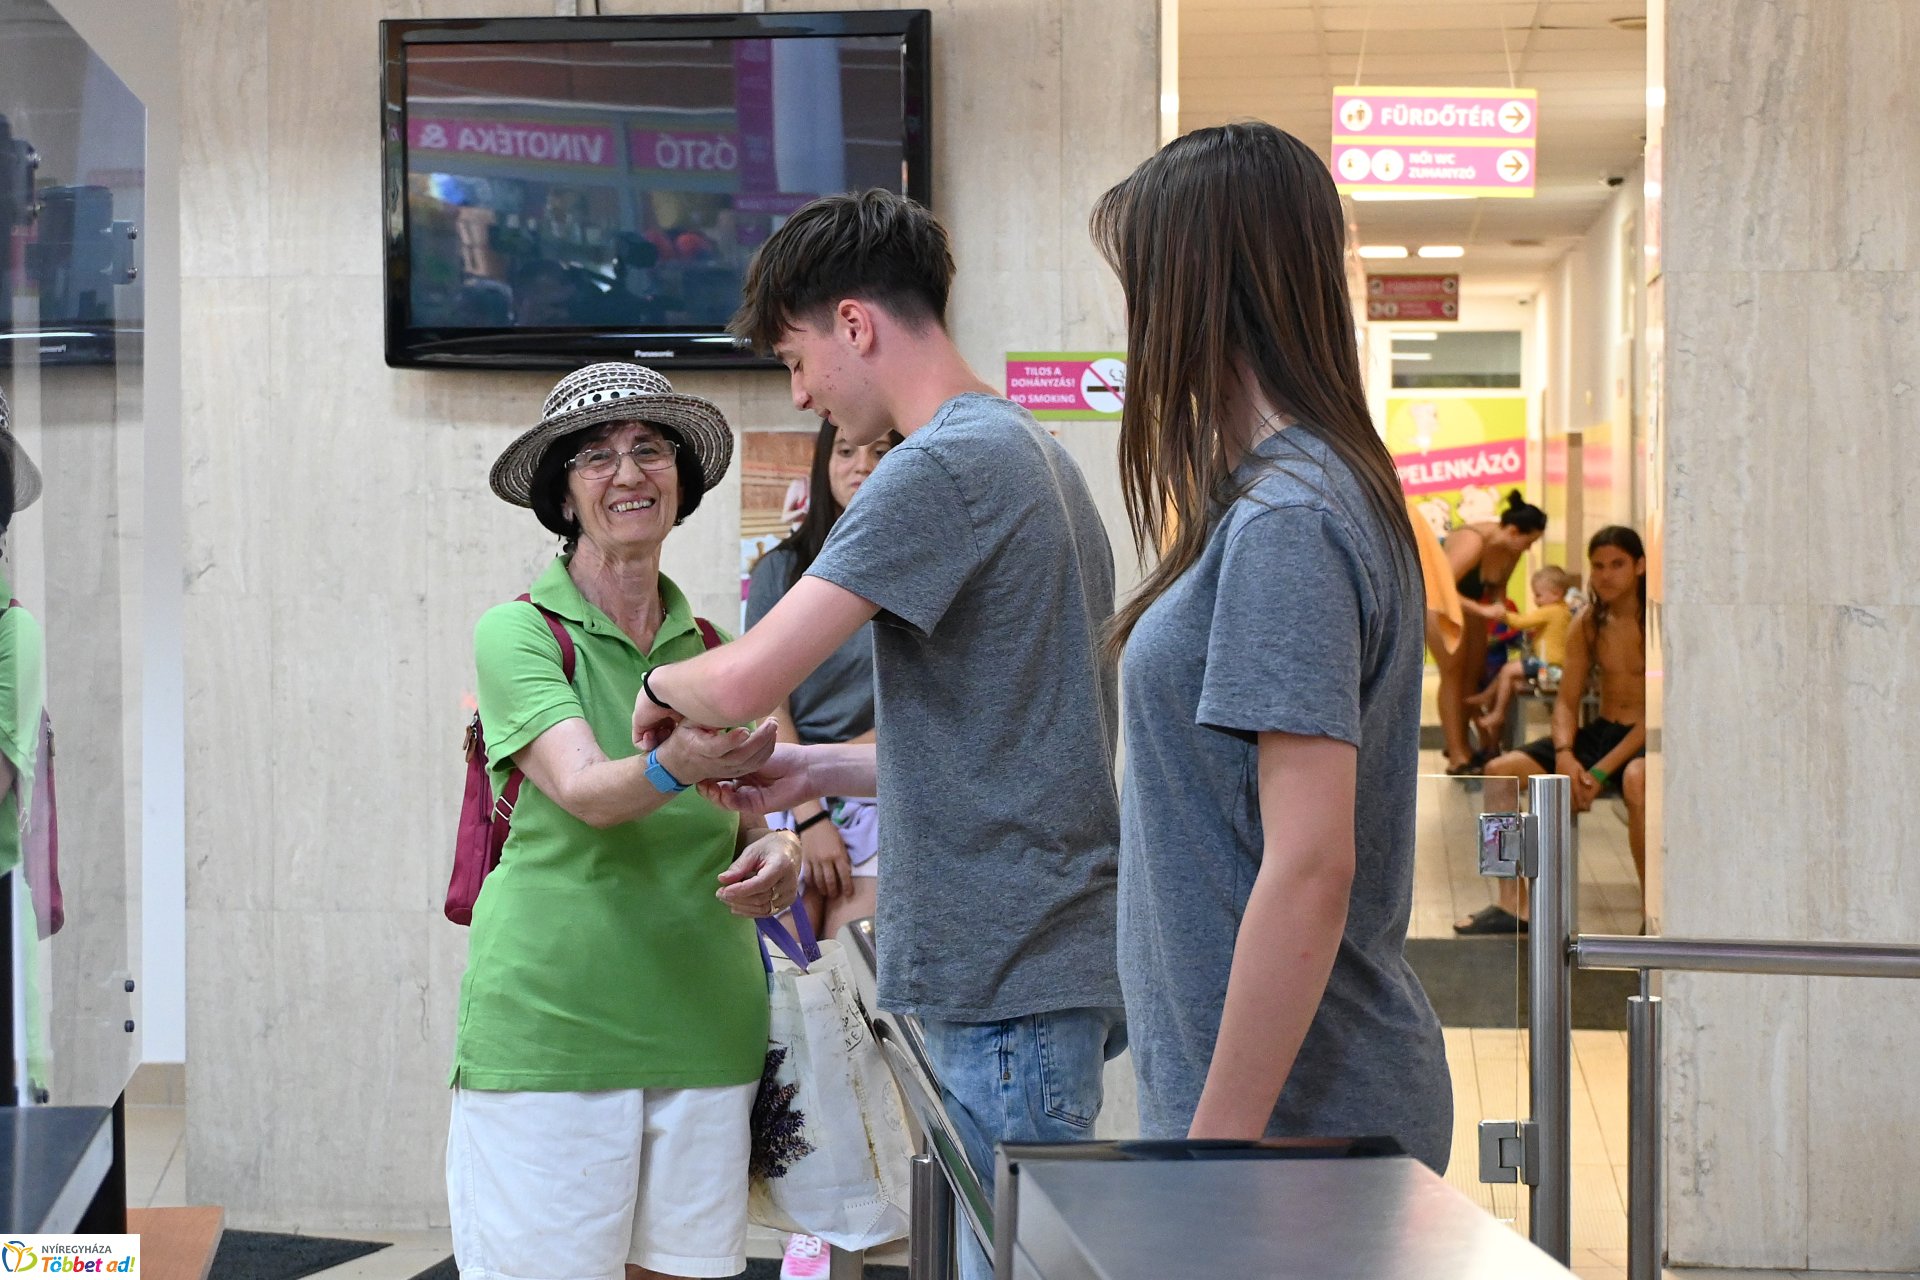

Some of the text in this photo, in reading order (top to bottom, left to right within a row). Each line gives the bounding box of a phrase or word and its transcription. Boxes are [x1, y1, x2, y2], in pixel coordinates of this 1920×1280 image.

[1381, 104, 1495, 127] FÜRDŐTÉR
[1434, 153, 1456, 165] WC
[1024, 367, 1062, 376] TILOS A
[1011, 376, 1076, 388] DOHÁNYZÁS!
[1027, 394, 1076, 404] SMOKING
